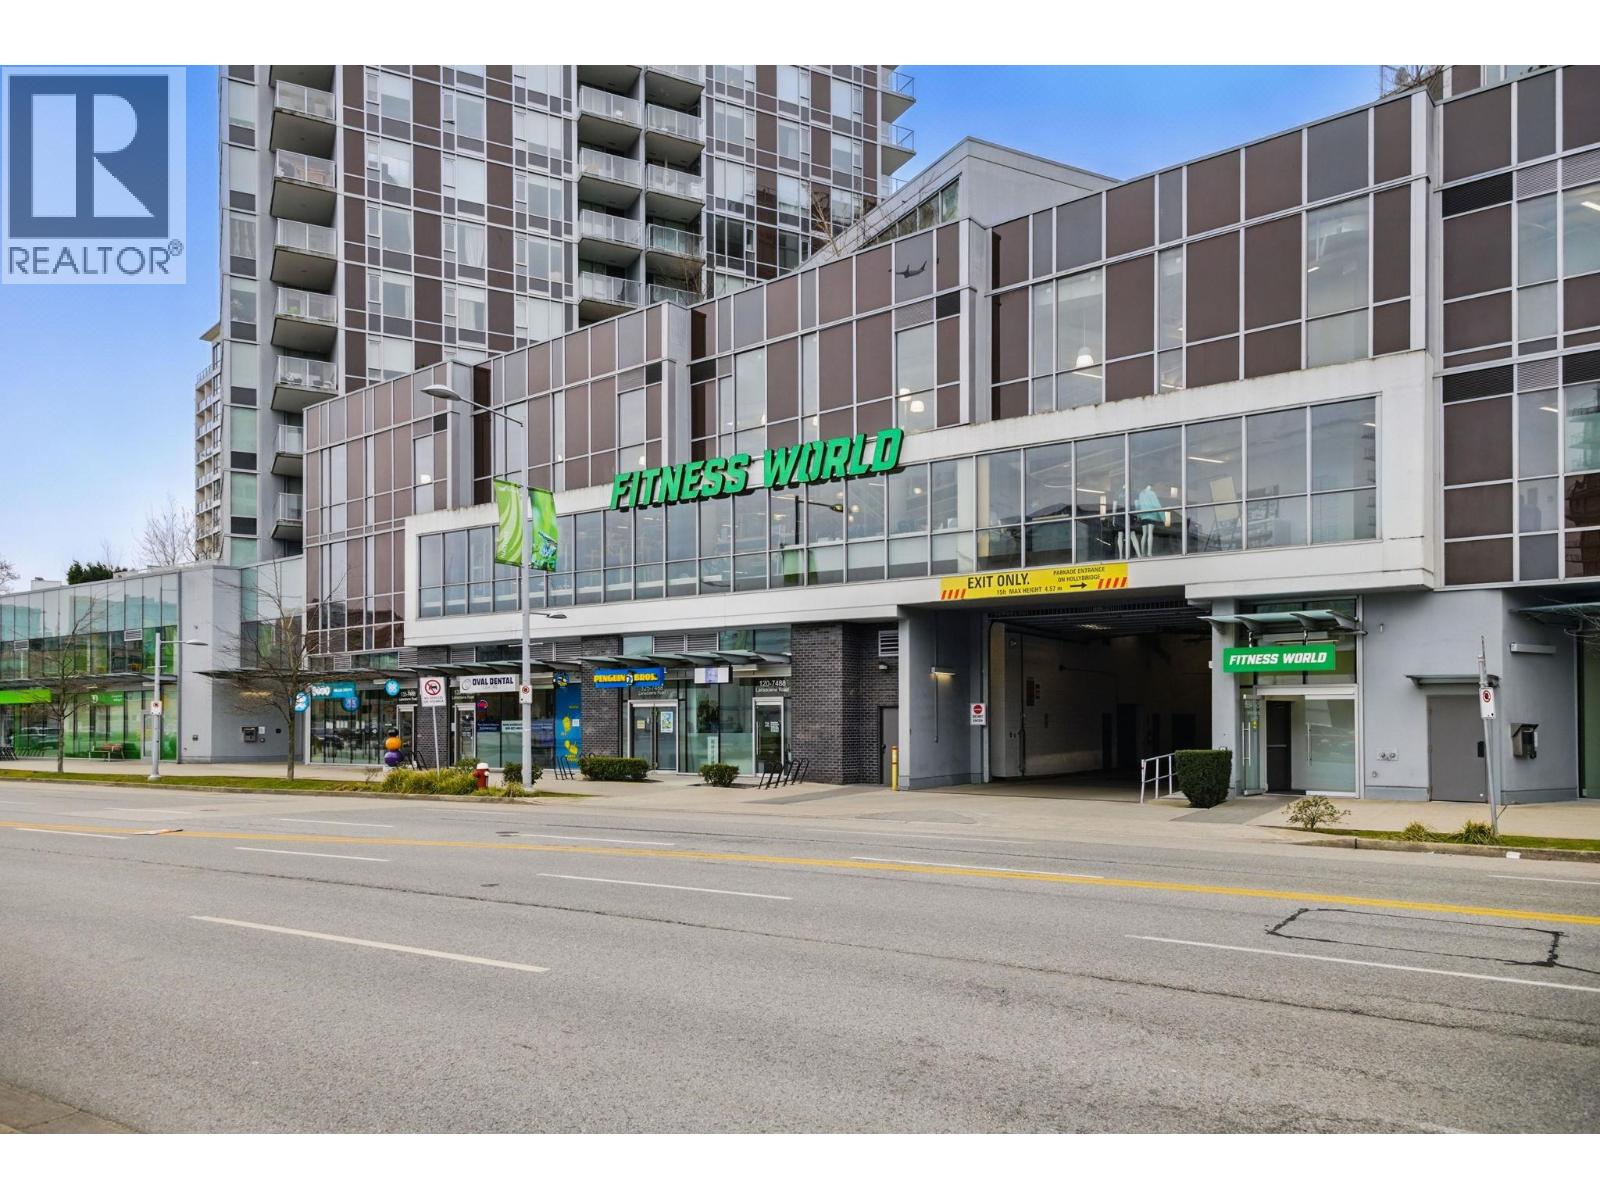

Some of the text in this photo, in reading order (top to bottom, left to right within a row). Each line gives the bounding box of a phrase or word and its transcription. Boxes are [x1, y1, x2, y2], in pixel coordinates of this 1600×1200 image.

[610, 427, 905, 511] FITNESS WORLD
[1053, 566, 1105, 576] PARKADE ENTRANCE
[968, 572, 1030, 589] EXIT ONLY.
[1229, 652, 1327, 665] FITNESS WORLD
[472, 676, 514, 686] OVAL DENTAL
